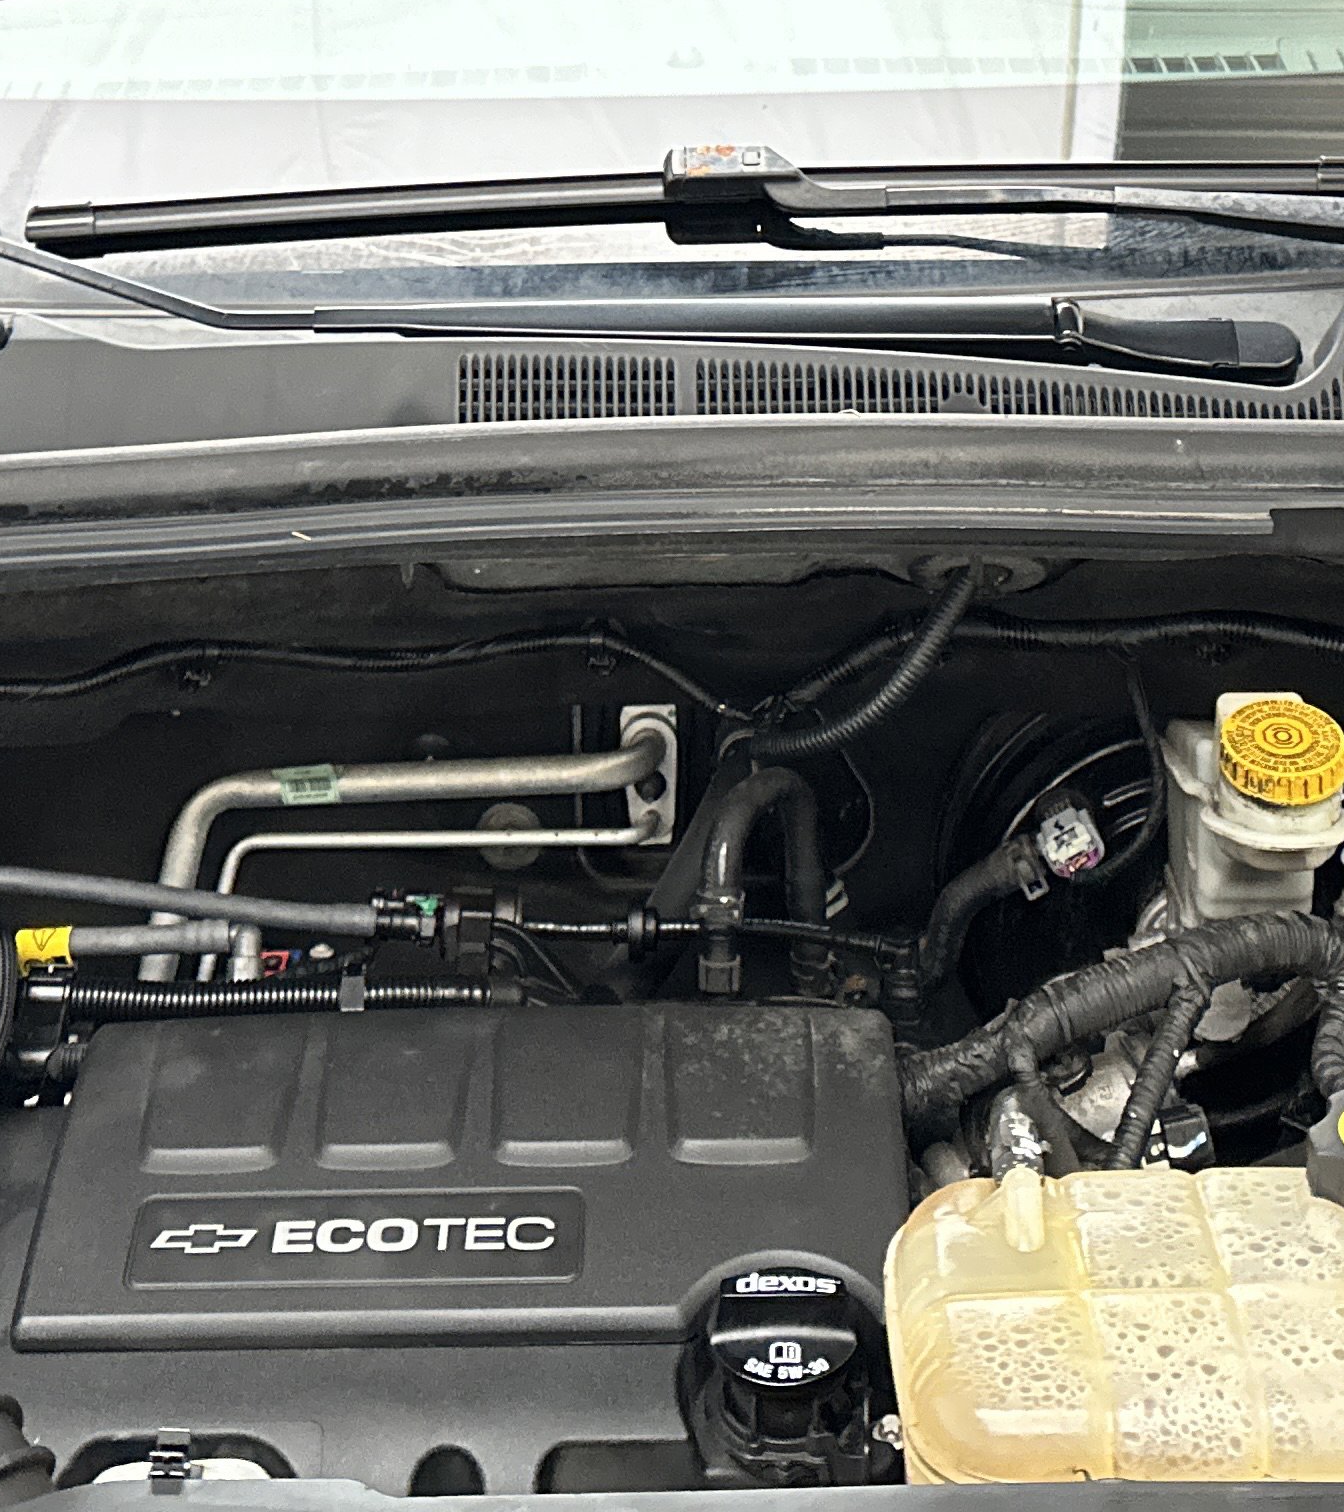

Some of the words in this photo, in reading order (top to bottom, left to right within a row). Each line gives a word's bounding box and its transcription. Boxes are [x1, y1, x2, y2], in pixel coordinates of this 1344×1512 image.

[271, 1216, 556, 1254] ECOTEC
[735, 1271, 837, 1294] dexos
[743, 1357, 775, 1379] SAE
[777, 1357, 830, 1380] 5W-30
